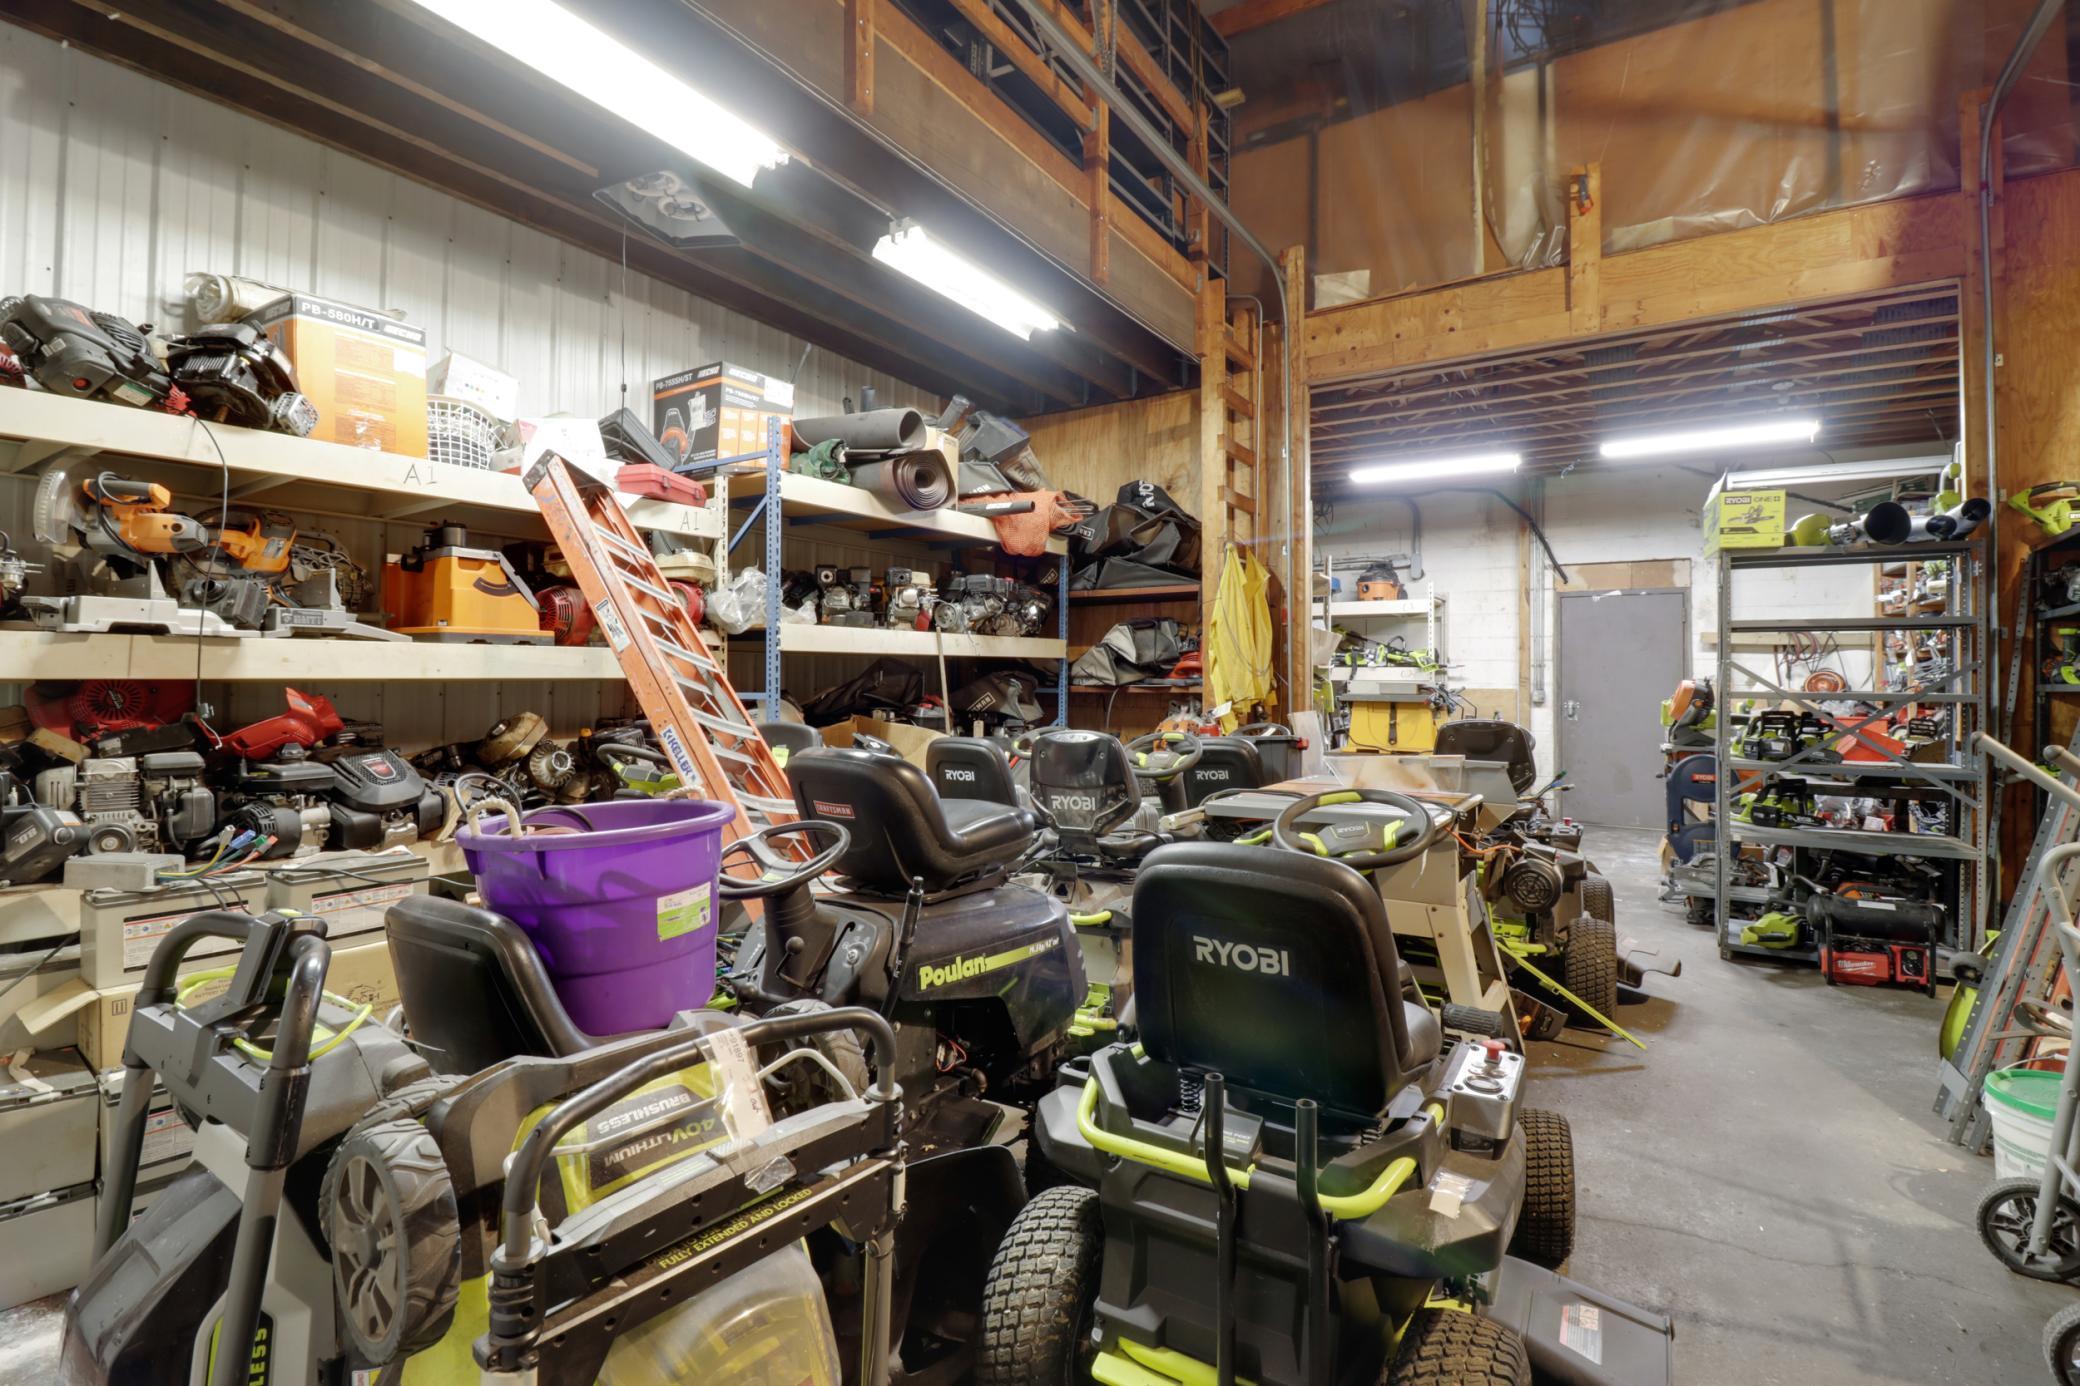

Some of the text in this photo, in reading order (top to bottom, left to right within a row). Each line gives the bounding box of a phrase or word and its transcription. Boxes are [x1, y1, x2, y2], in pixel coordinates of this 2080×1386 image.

[665, 736, 695, 778] KELLER
[945, 769, 976, 782] RYOBI
[1195, 769, 1230, 780] RYOBI
[1050, 795, 1096, 811] RYOBI
[919, 955, 986, 991] Poulan
[1192, 935, 1290, 977] RYOBI
[596, 1093, 692, 1135] BRUSHLESS
[658, 1247, 693, 1270] FULLY
[694, 1220, 750, 1252] EXTENDED
[750, 1207, 774, 1225] AND
[773, 1186, 814, 1212] LOCKED
